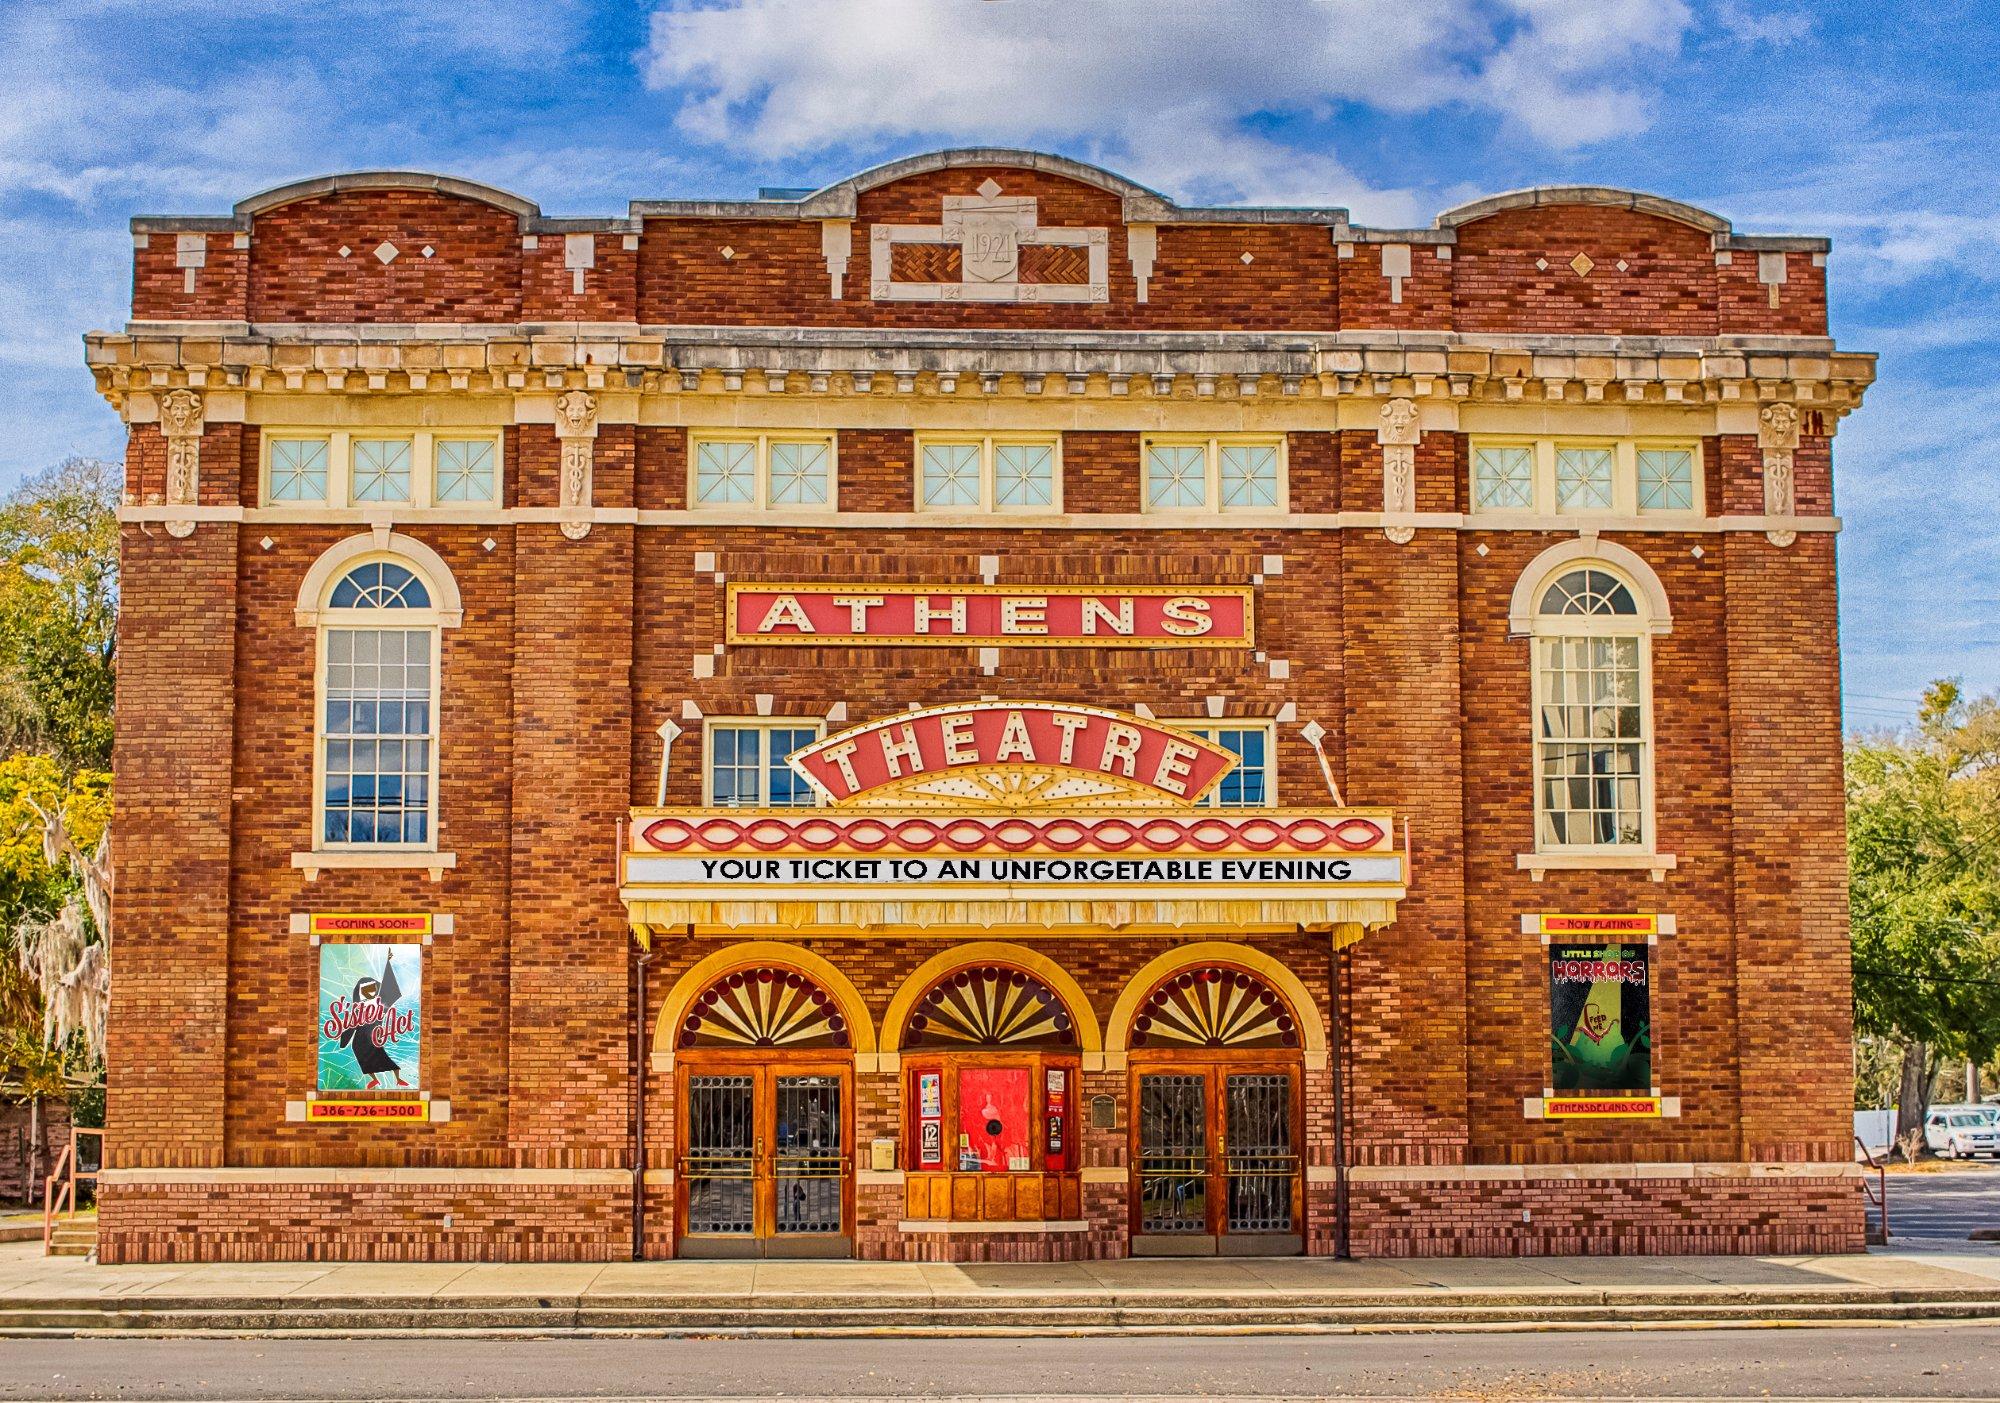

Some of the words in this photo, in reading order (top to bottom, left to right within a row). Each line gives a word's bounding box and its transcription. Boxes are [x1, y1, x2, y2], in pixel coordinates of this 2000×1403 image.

[971, 232, 1011, 264] 1921
[757, 595, 1213, 636] ATHENS
[821, 711, 1200, 796] THEATRE
[701, 859, 779, 880] YOUR
[789, 859, 881, 880] TICKET
[889, 859, 927, 880] TO
[937, 859, 979, 880] AN
[991, 859, 1211, 880] UNFORGETABLE
[1221, 859, 1351, 880] EVENING
[1567, 919, 1589, 929] NOW
[1593, 920, 1633, 930] PLAYING
[1561, 950, 1591, 958] LITTLE
[1593, 950, 1620, 958] SHOP
[1552, 960, 1646, 986] HORRORS
[323, 995, 385, 1040] Sister
[371, 1007, 415, 1048] Act
[320, 1105, 415, 1116] 386-736-1500
[1552, 1102, 1655, 1113] ATHENSDELAND.COM
